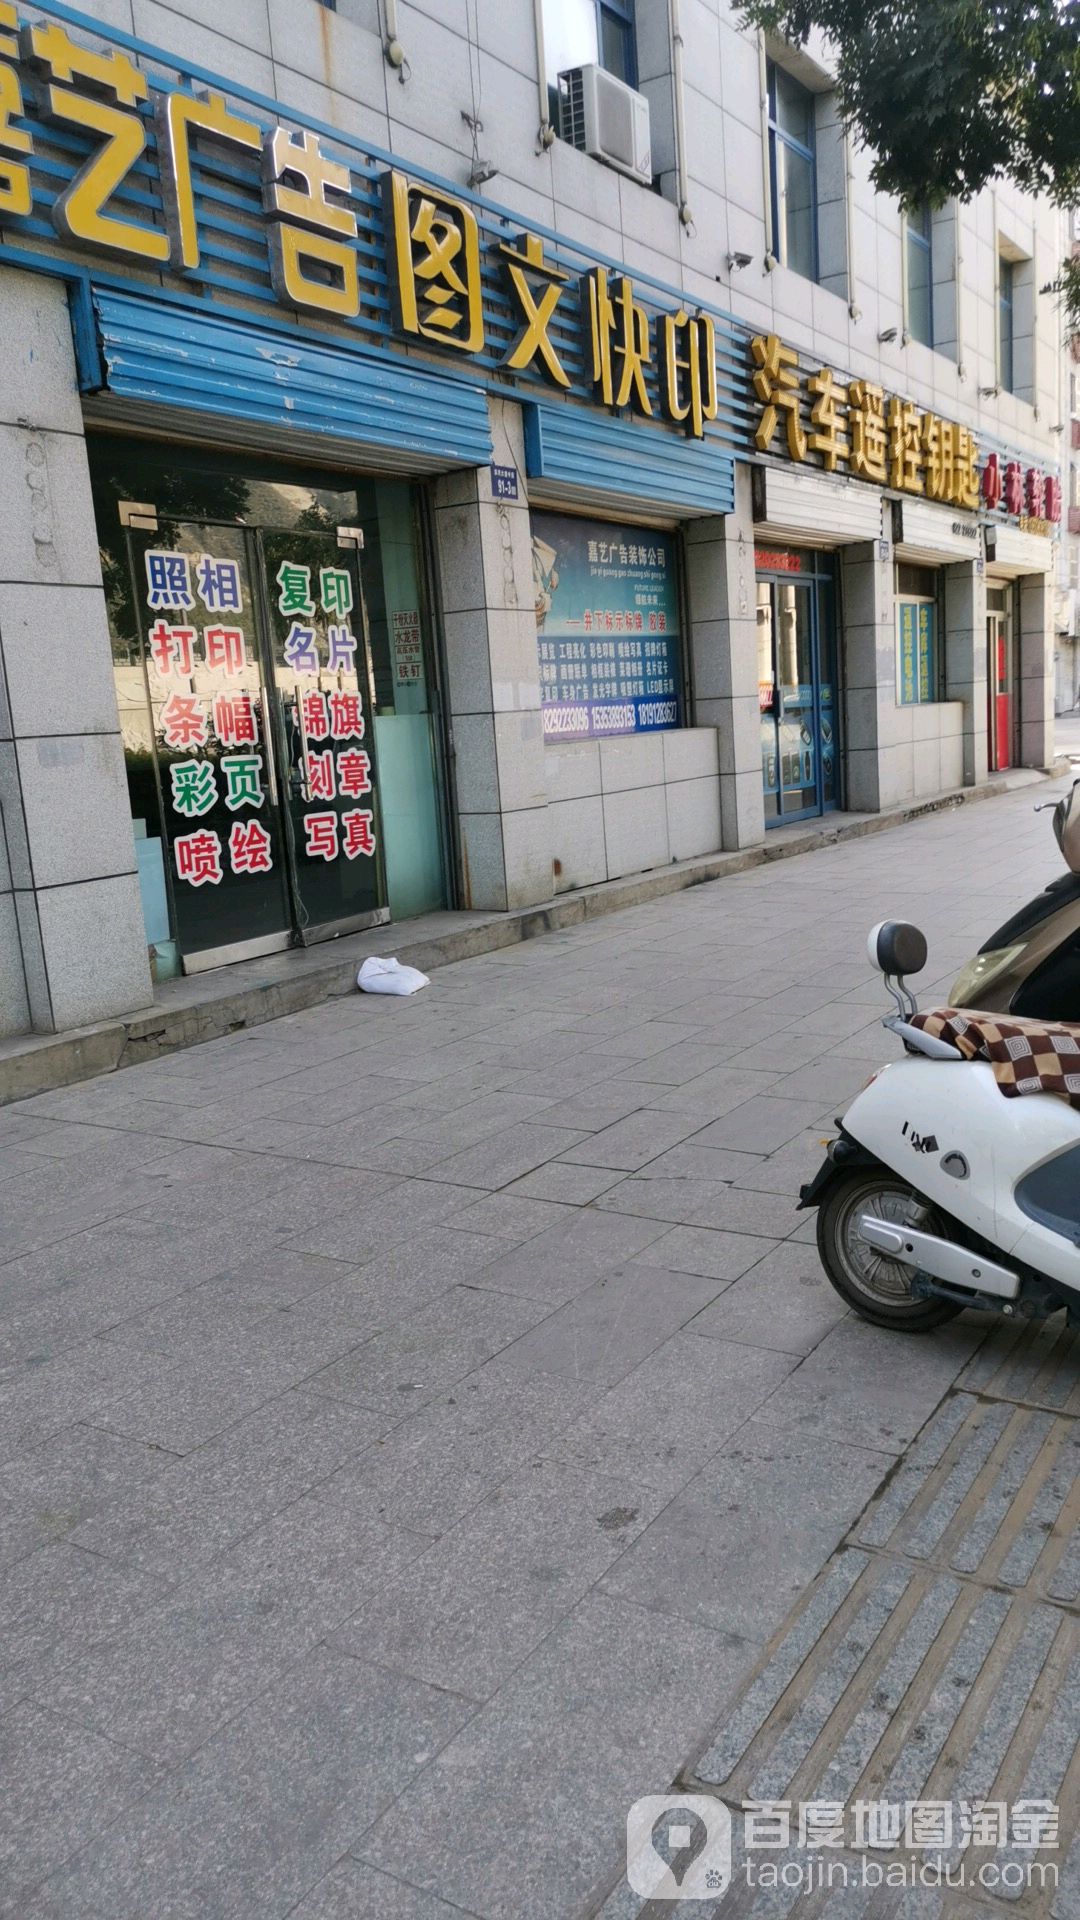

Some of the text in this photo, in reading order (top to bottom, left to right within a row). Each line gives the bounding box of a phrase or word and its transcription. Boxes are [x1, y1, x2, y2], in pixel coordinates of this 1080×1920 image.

[751, 334, 980, 510] 汽车遥控钥匙
[146, 550, 243, 613] 照相
[587, 540, 666, 568] 嘉艺广告装饰公司
[277, 561, 353, 619] 复印
[149, 619, 245, 678] 打印
[284, 623, 357, 676] 名片
[395, 630, 420, 645] 水龙带
[399, 665, 421, 679] 铁钉
[562, 683, 589, 702] 车身广告
[647, 679, 674, 694] LED显示屏
[162, 692, 259, 748] 条幅
[294, 688, 364, 743] 锦旗
[171, 755, 264, 818] 彩页
[174, 818, 273, 887] 喷绘
[304, 807, 376, 861] 写真
